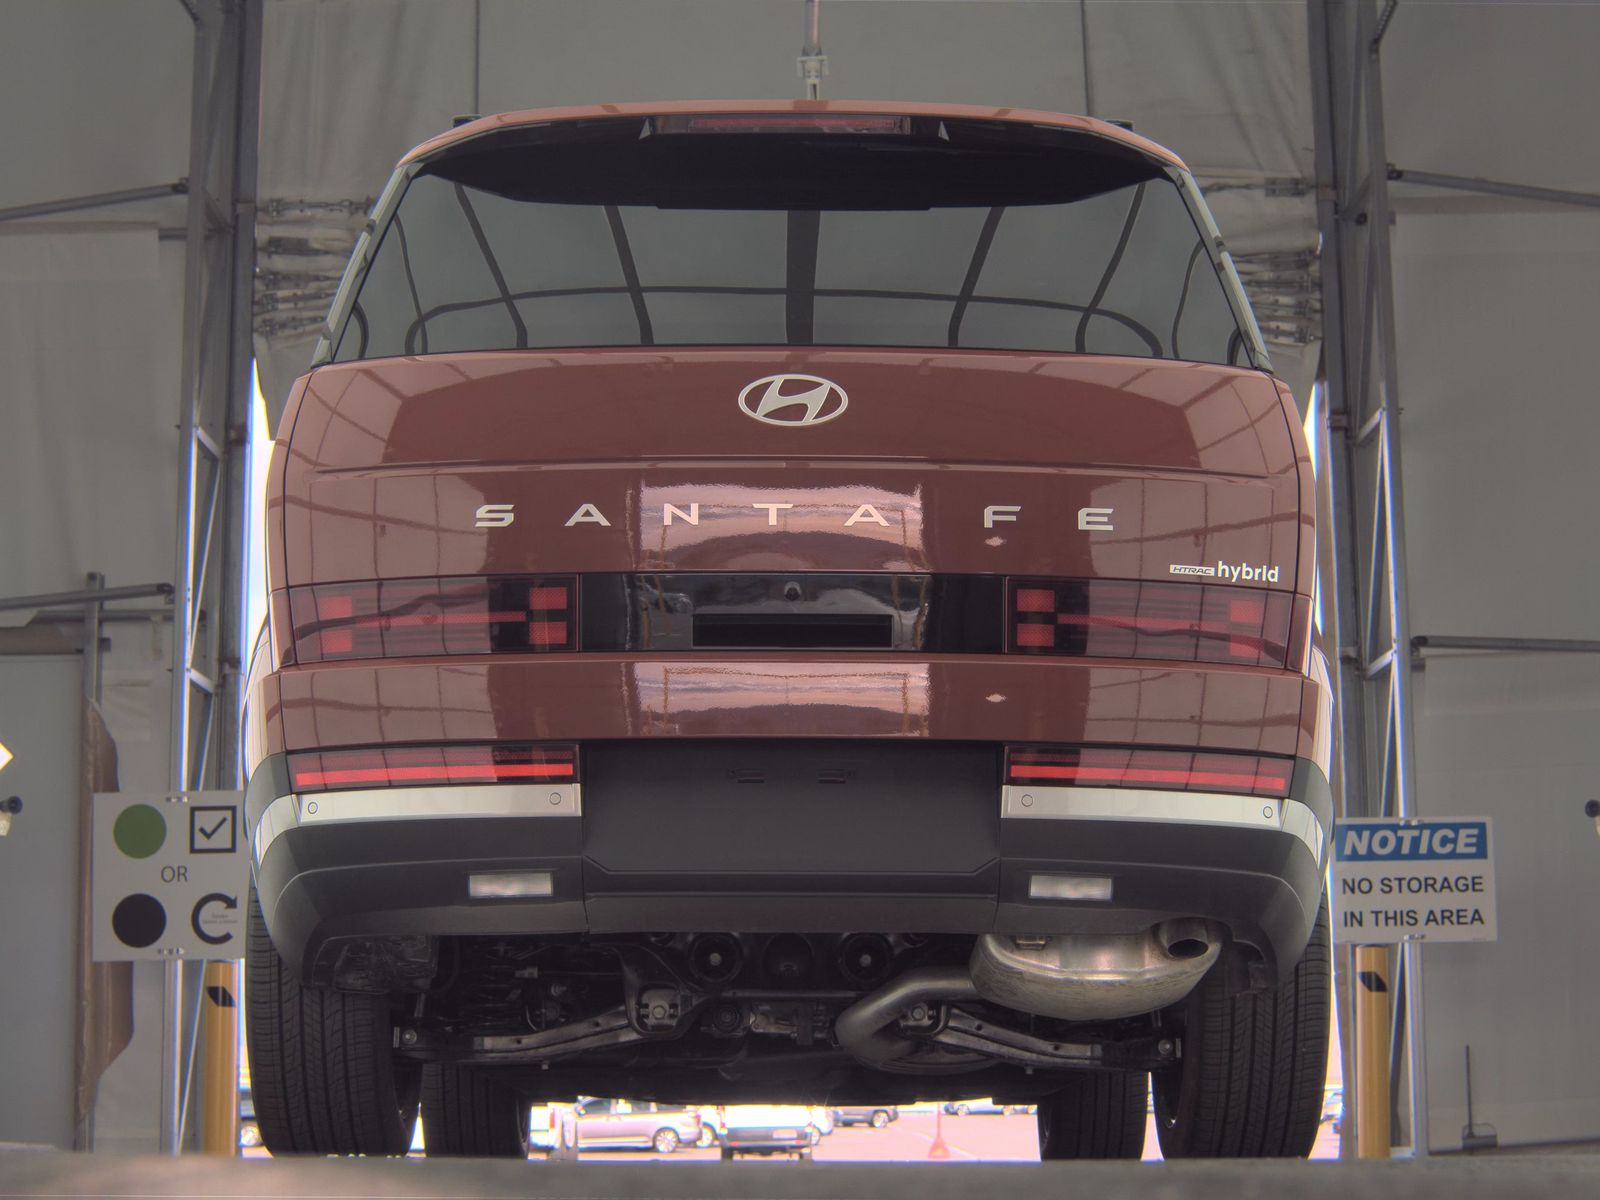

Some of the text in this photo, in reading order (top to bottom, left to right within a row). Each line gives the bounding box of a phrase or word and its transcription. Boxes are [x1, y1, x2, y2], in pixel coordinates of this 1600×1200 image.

[475, 503, 1114, 531] SANTA FE
[1171, 560, 1280, 583] HTRAC hybrid
[1343, 828, 1479, 856] NOTICE
[160, 865, 188, 883] OR
[1341, 875, 1485, 895] NO STORAGE
[1343, 908, 1485, 928] IN THIS AREA
